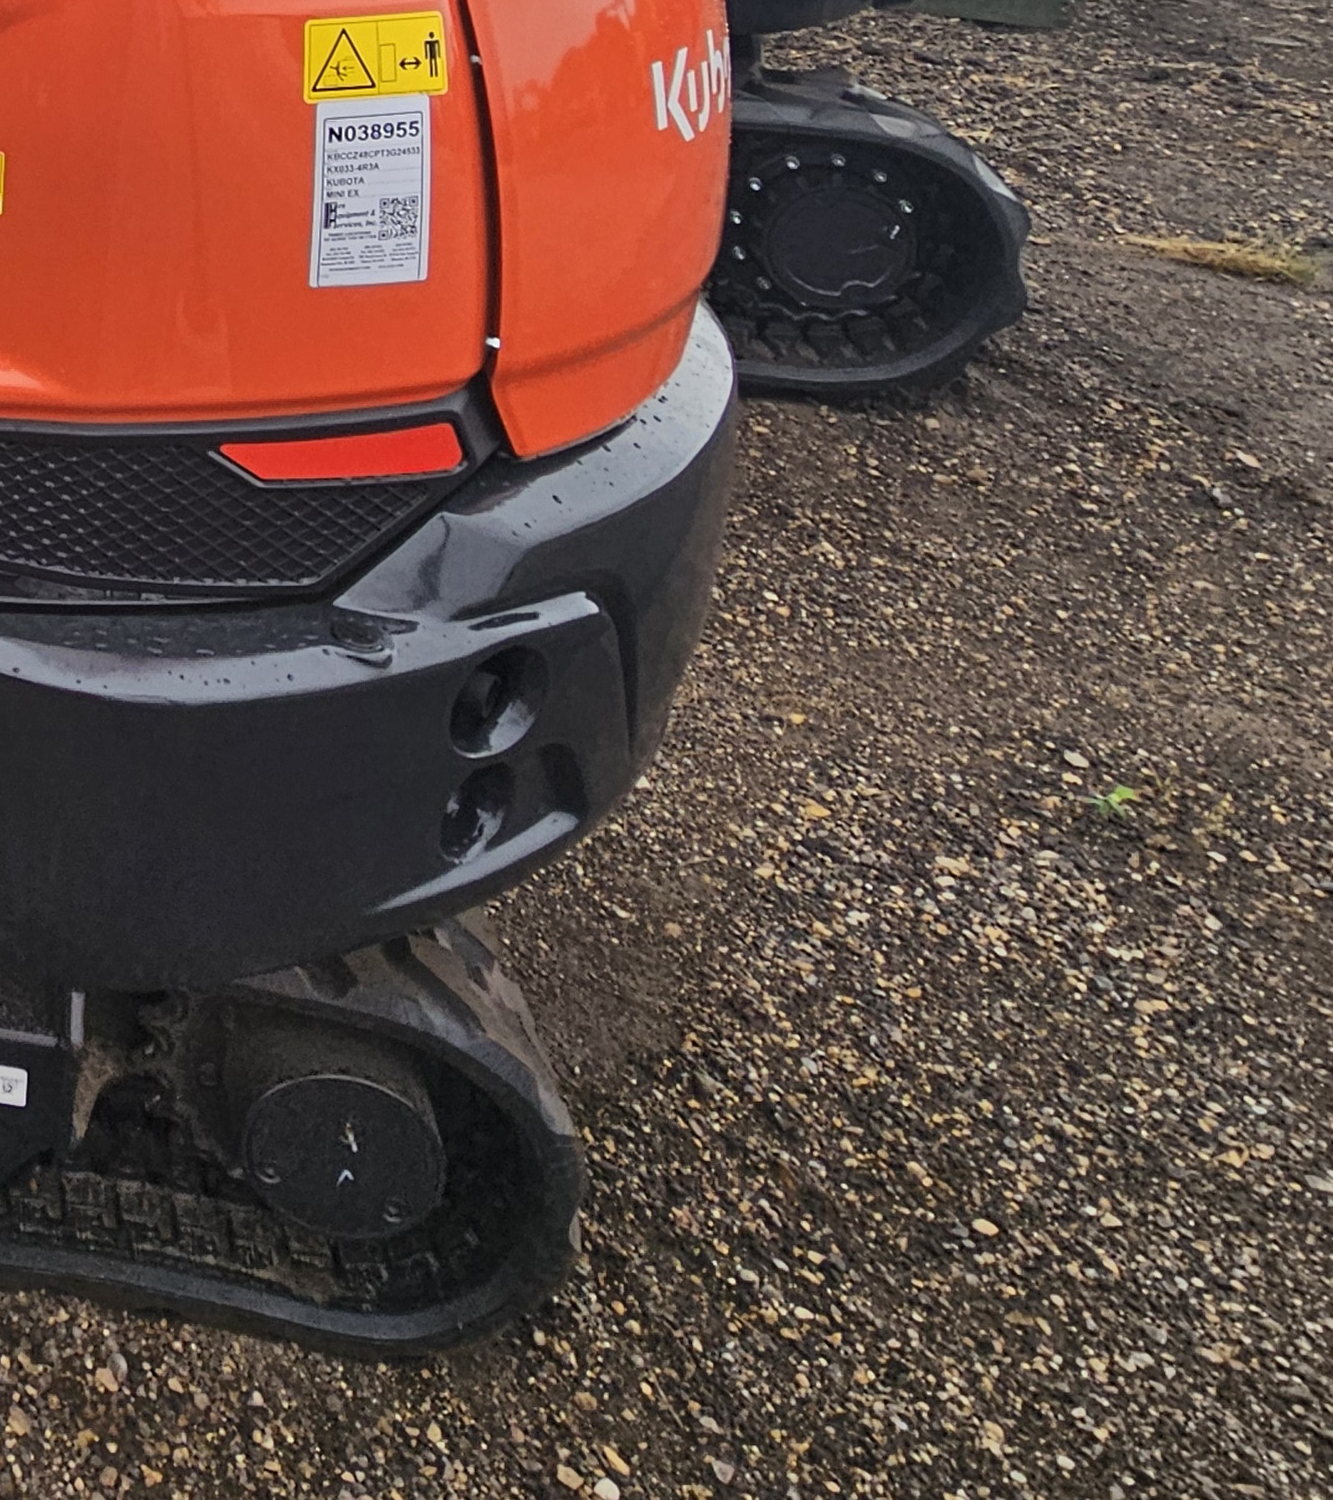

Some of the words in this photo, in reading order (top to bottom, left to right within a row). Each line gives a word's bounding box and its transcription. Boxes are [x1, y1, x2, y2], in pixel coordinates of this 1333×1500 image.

[328, 120, 420, 143] N038955
[326, 176, 365, 187] KUBOTA
[326, 190, 345, 198] MINI
[347, 189, 360, 197] EX
